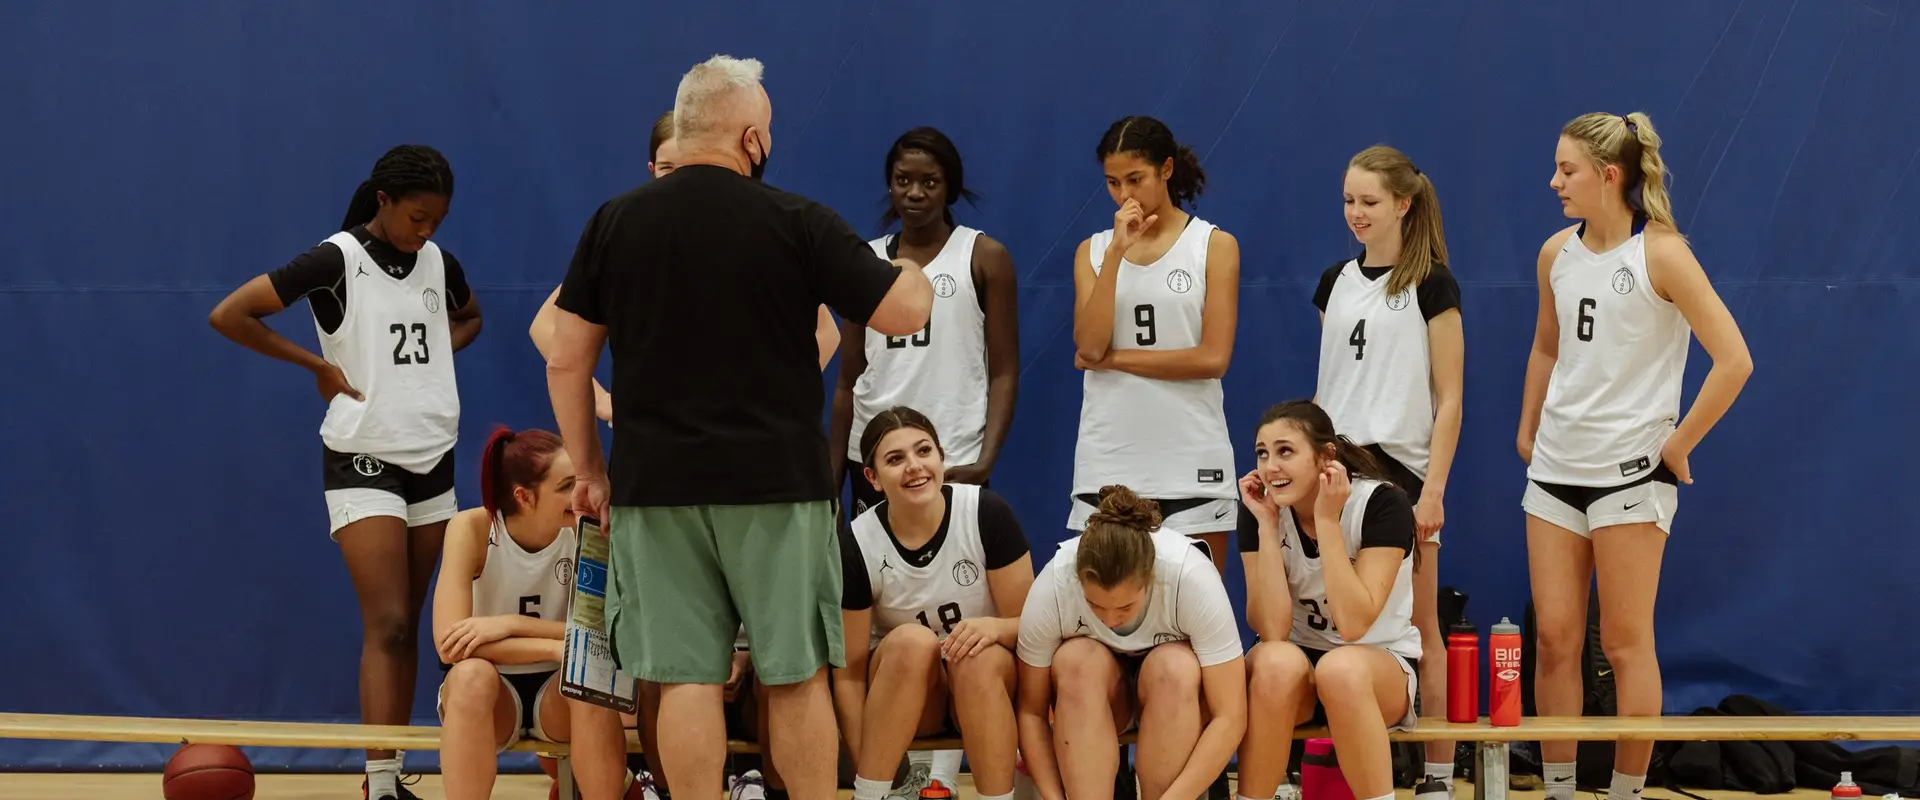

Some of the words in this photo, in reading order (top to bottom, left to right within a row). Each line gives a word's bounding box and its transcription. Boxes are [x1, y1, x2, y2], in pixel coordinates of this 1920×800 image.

[1134, 303, 1157, 346] 9
[1349, 318, 1367, 361] 4
[1577, 297, 1597, 342] 6
[389, 322, 430, 365] 23
[1495, 647, 1522, 661] BIO
